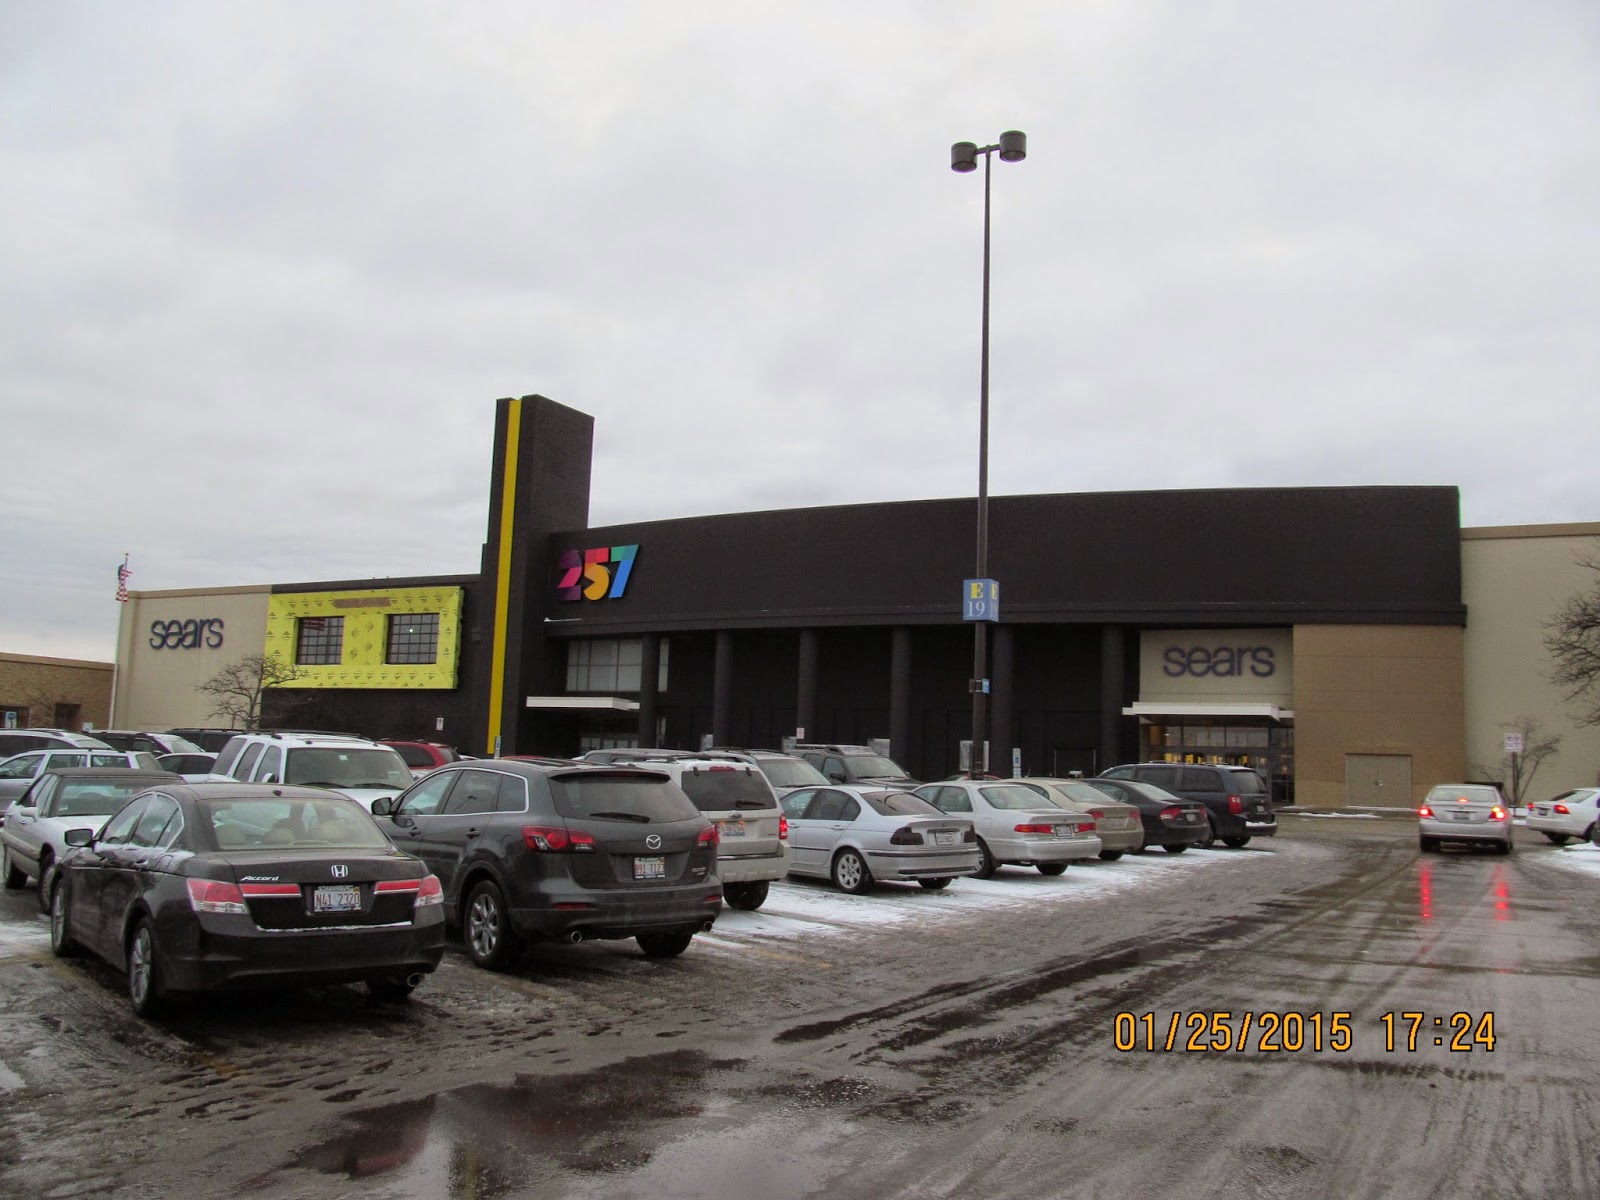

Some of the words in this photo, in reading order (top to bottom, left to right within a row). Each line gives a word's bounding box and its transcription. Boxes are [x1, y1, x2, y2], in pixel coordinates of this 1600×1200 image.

[558, 544, 639, 601] 257
[970, 582, 984, 599] E
[967, 600, 986, 617] 19
[149, 617, 224, 650] sears
[1163, 646, 1275, 677] sears
[316, 894, 332, 907] N41
[338, 892, 360, 906] 2320
